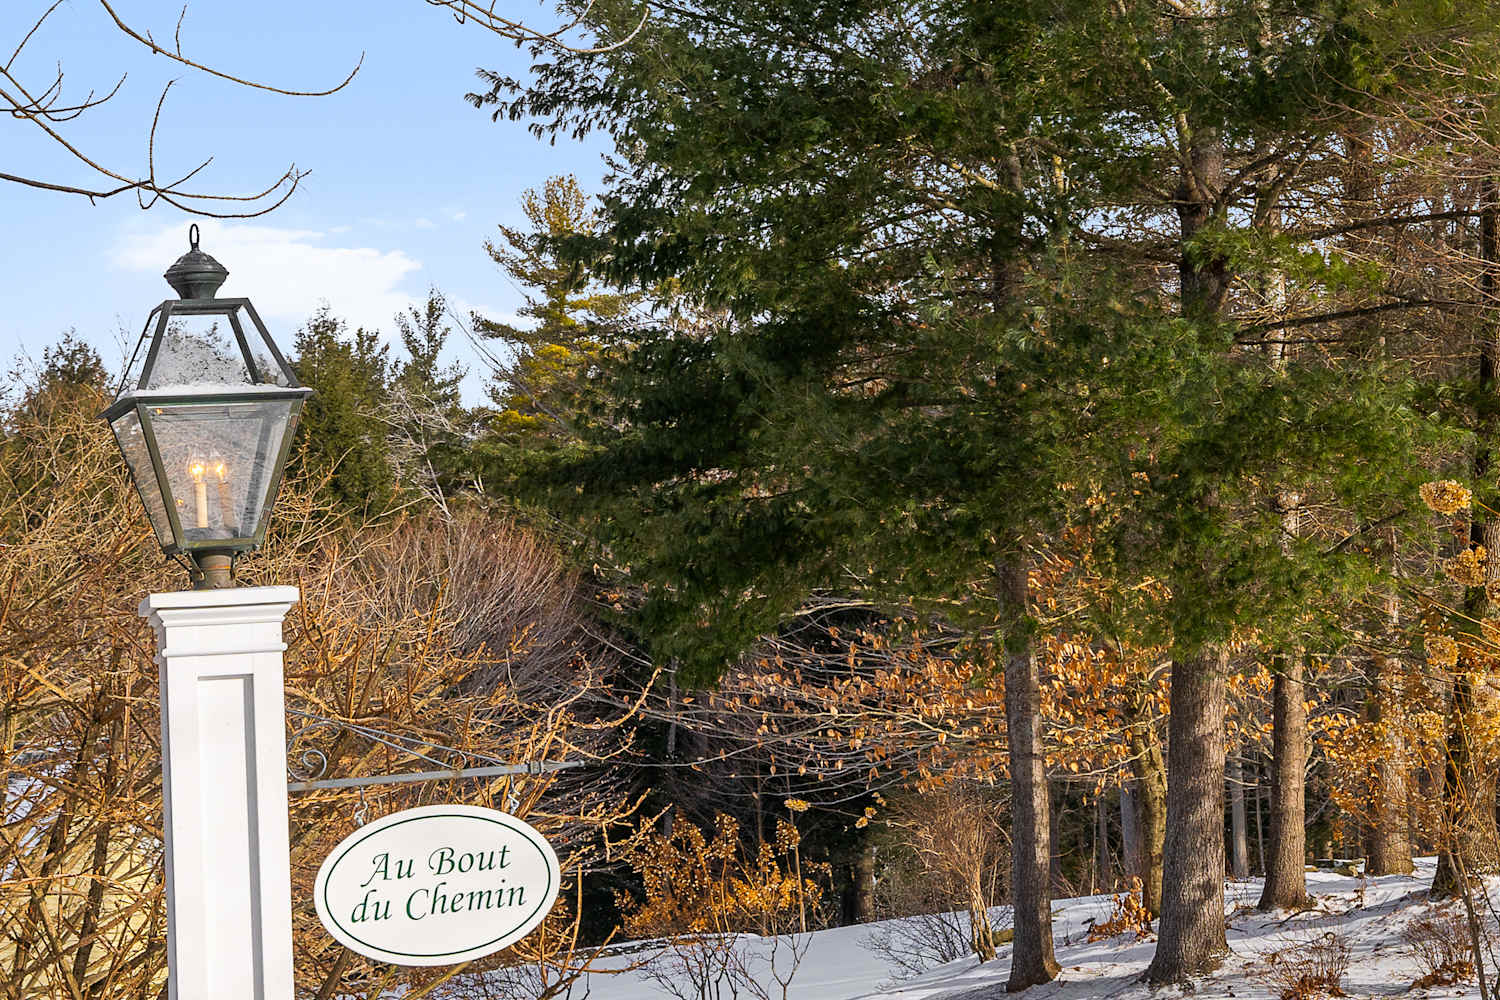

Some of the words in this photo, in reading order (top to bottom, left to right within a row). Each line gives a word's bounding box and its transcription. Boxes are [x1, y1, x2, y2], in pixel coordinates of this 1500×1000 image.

[360, 853, 415, 888] Au
[428, 845, 511, 876] Bout
[351, 889, 392, 923] du
[406, 879, 527, 921] Chemin
